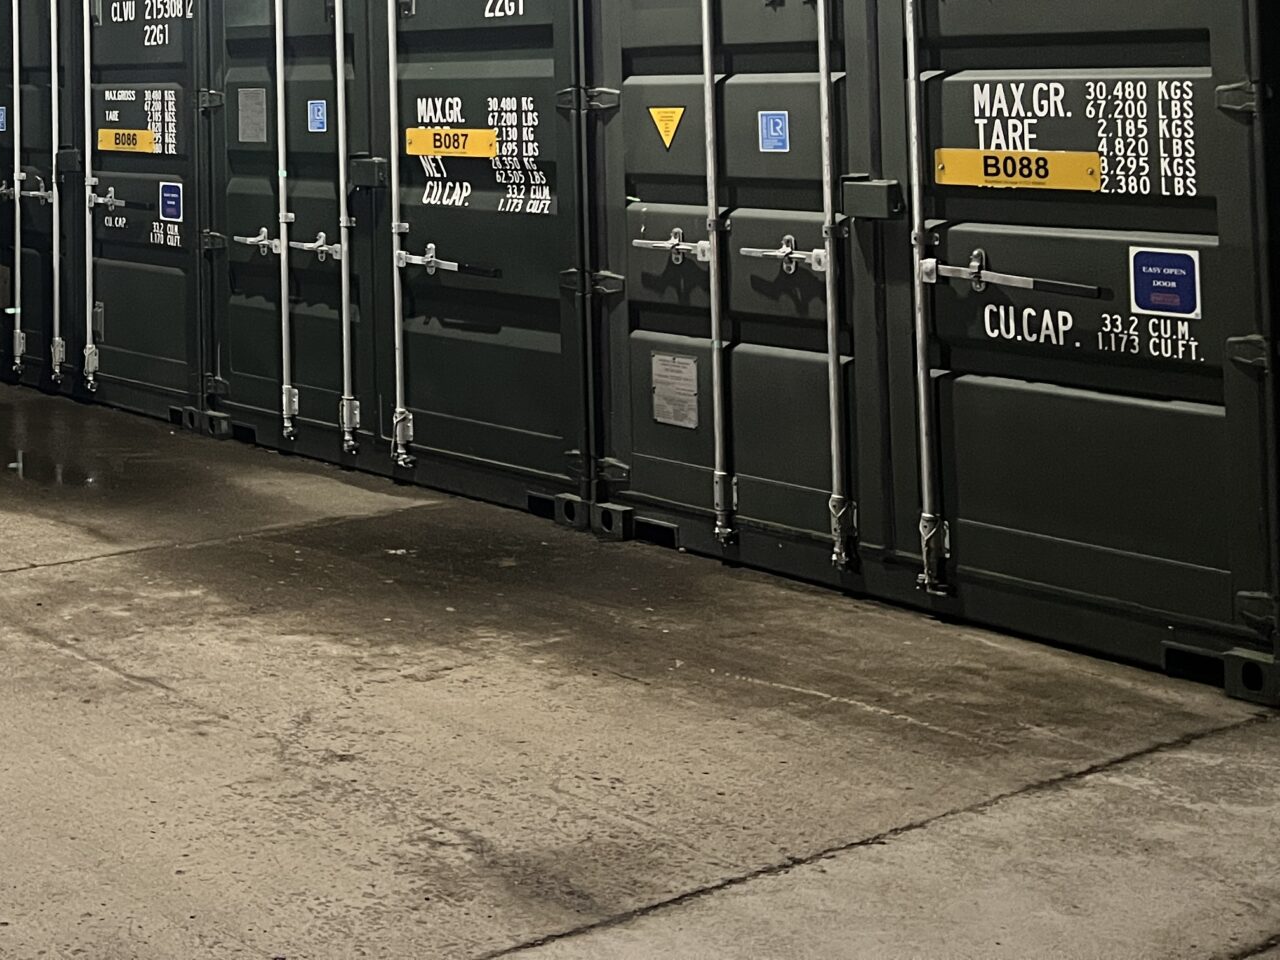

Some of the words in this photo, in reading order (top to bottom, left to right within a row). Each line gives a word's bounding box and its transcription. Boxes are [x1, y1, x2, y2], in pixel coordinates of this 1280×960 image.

[111, 0, 136, 22] CLVU
[144, 24, 168, 46] 22G1
[973, 82, 1072, 118] MAX.GR.
[1157, 81, 1193, 100] KGS
[1158, 100, 1194, 119] LBS
[417, 97, 466, 124] MAX.GR.
[487, 97, 517, 111] 30.480
[521, 97, 534, 111] KG
[488, 112, 518, 126] 67.200
[522, 112, 539, 126] LBS
[114, 133, 137, 146] B086
[432, 133, 468, 149] B087
[522, 127, 534, 141] KG
[974, 119, 1039, 150] TARE
[1158, 119, 1195, 138] KGS
[522, 142, 539, 156] LBS
[1159, 138, 1195, 157] LBS
[419, 155, 447, 178] NET
[522, 157, 537, 170] KG
[982, 155, 1050, 179] B088
[1160, 157, 1196, 177] KGS
[527, 171, 546, 184] LBS
[1161, 176, 1197, 196] LBS
[422, 180, 471, 207] CU.CAP.
[506, 184, 525, 199] 33.2
[1142, 266, 1161, 274] EASY
[1163, 268, 1186, 276] OPEN
[1152, 280, 1177, 288] DOOR
[1101, 313, 1139, 335] 33.2
[1148, 318, 1194, 340] CU.M.
[1149, 337, 1205, 361] CU.FT.
